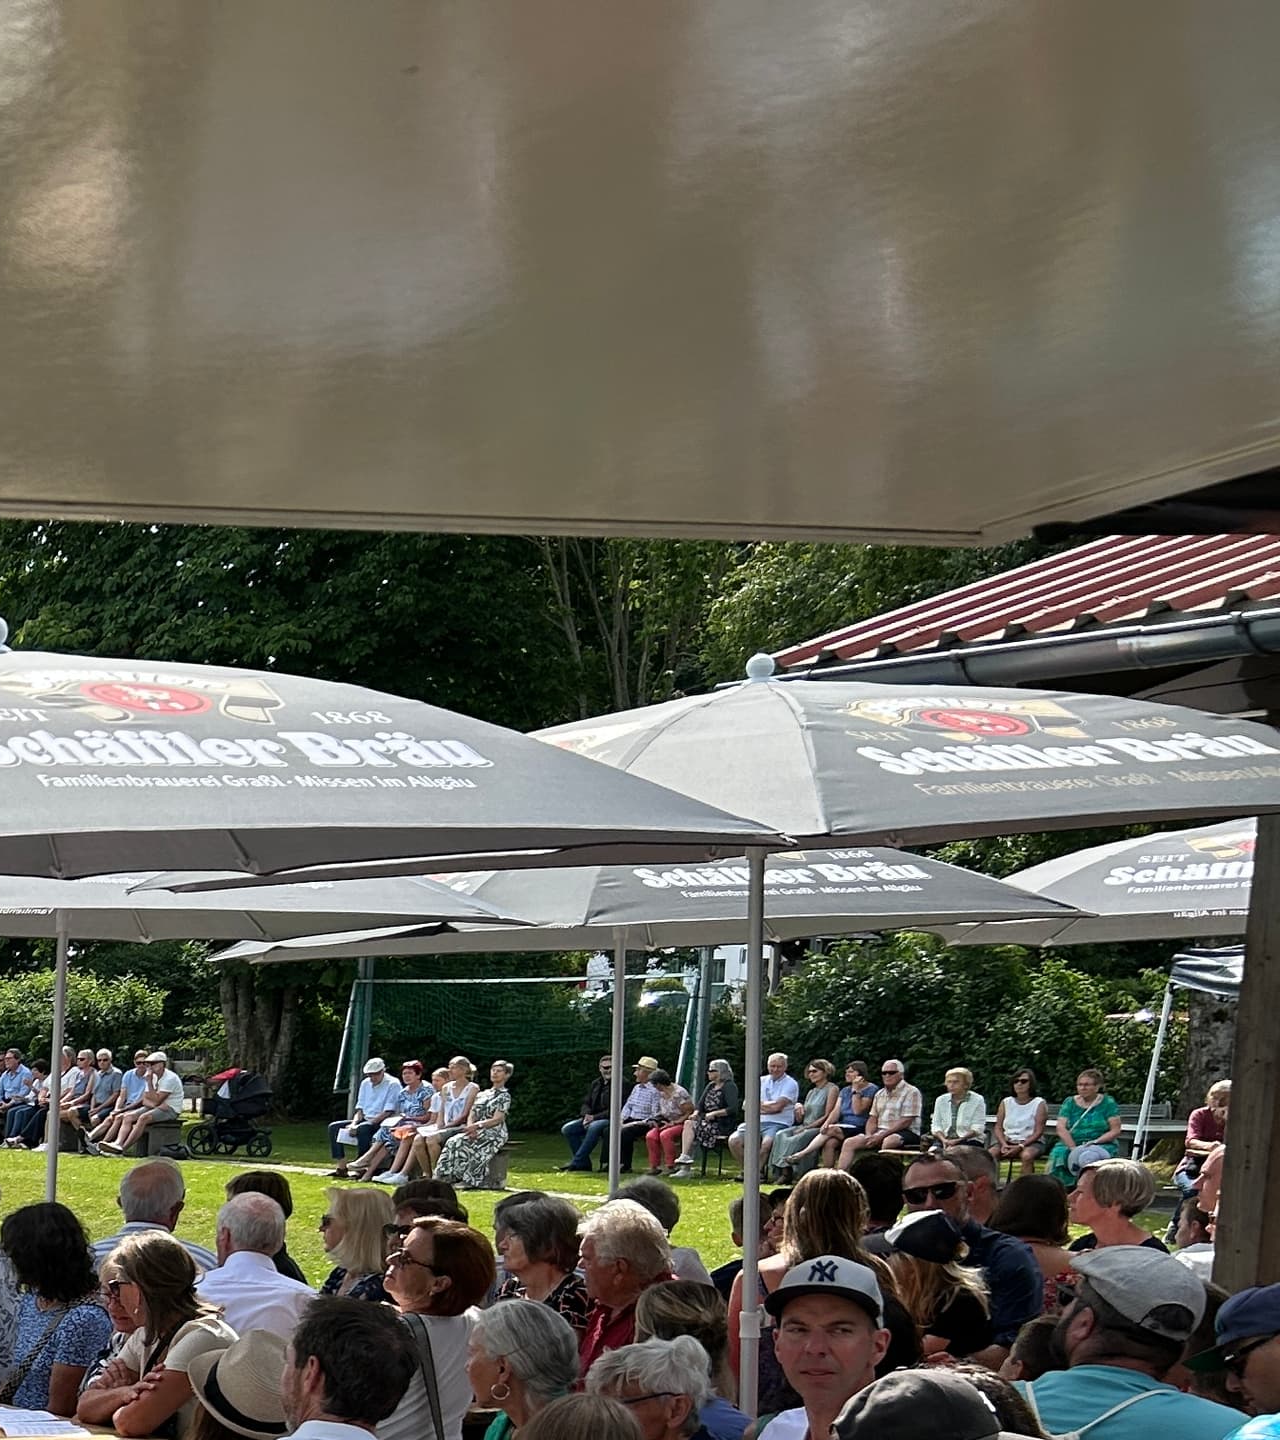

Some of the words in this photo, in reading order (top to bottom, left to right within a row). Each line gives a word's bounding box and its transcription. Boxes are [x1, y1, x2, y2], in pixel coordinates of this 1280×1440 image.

[310, 710, 393, 726] 1868
[277, 730, 495, 769] Bräu
[1095, 731, 1280, 763] Bräu
[36, 772, 222, 790] Familienbrauerei
[295, 773, 372, 789] Missen
[375, 775, 403, 788] im
[408, 774, 477, 792] Allgäu
[809, 862, 932, 882] Bräu
[808, 1260, 838, 1282] NY
